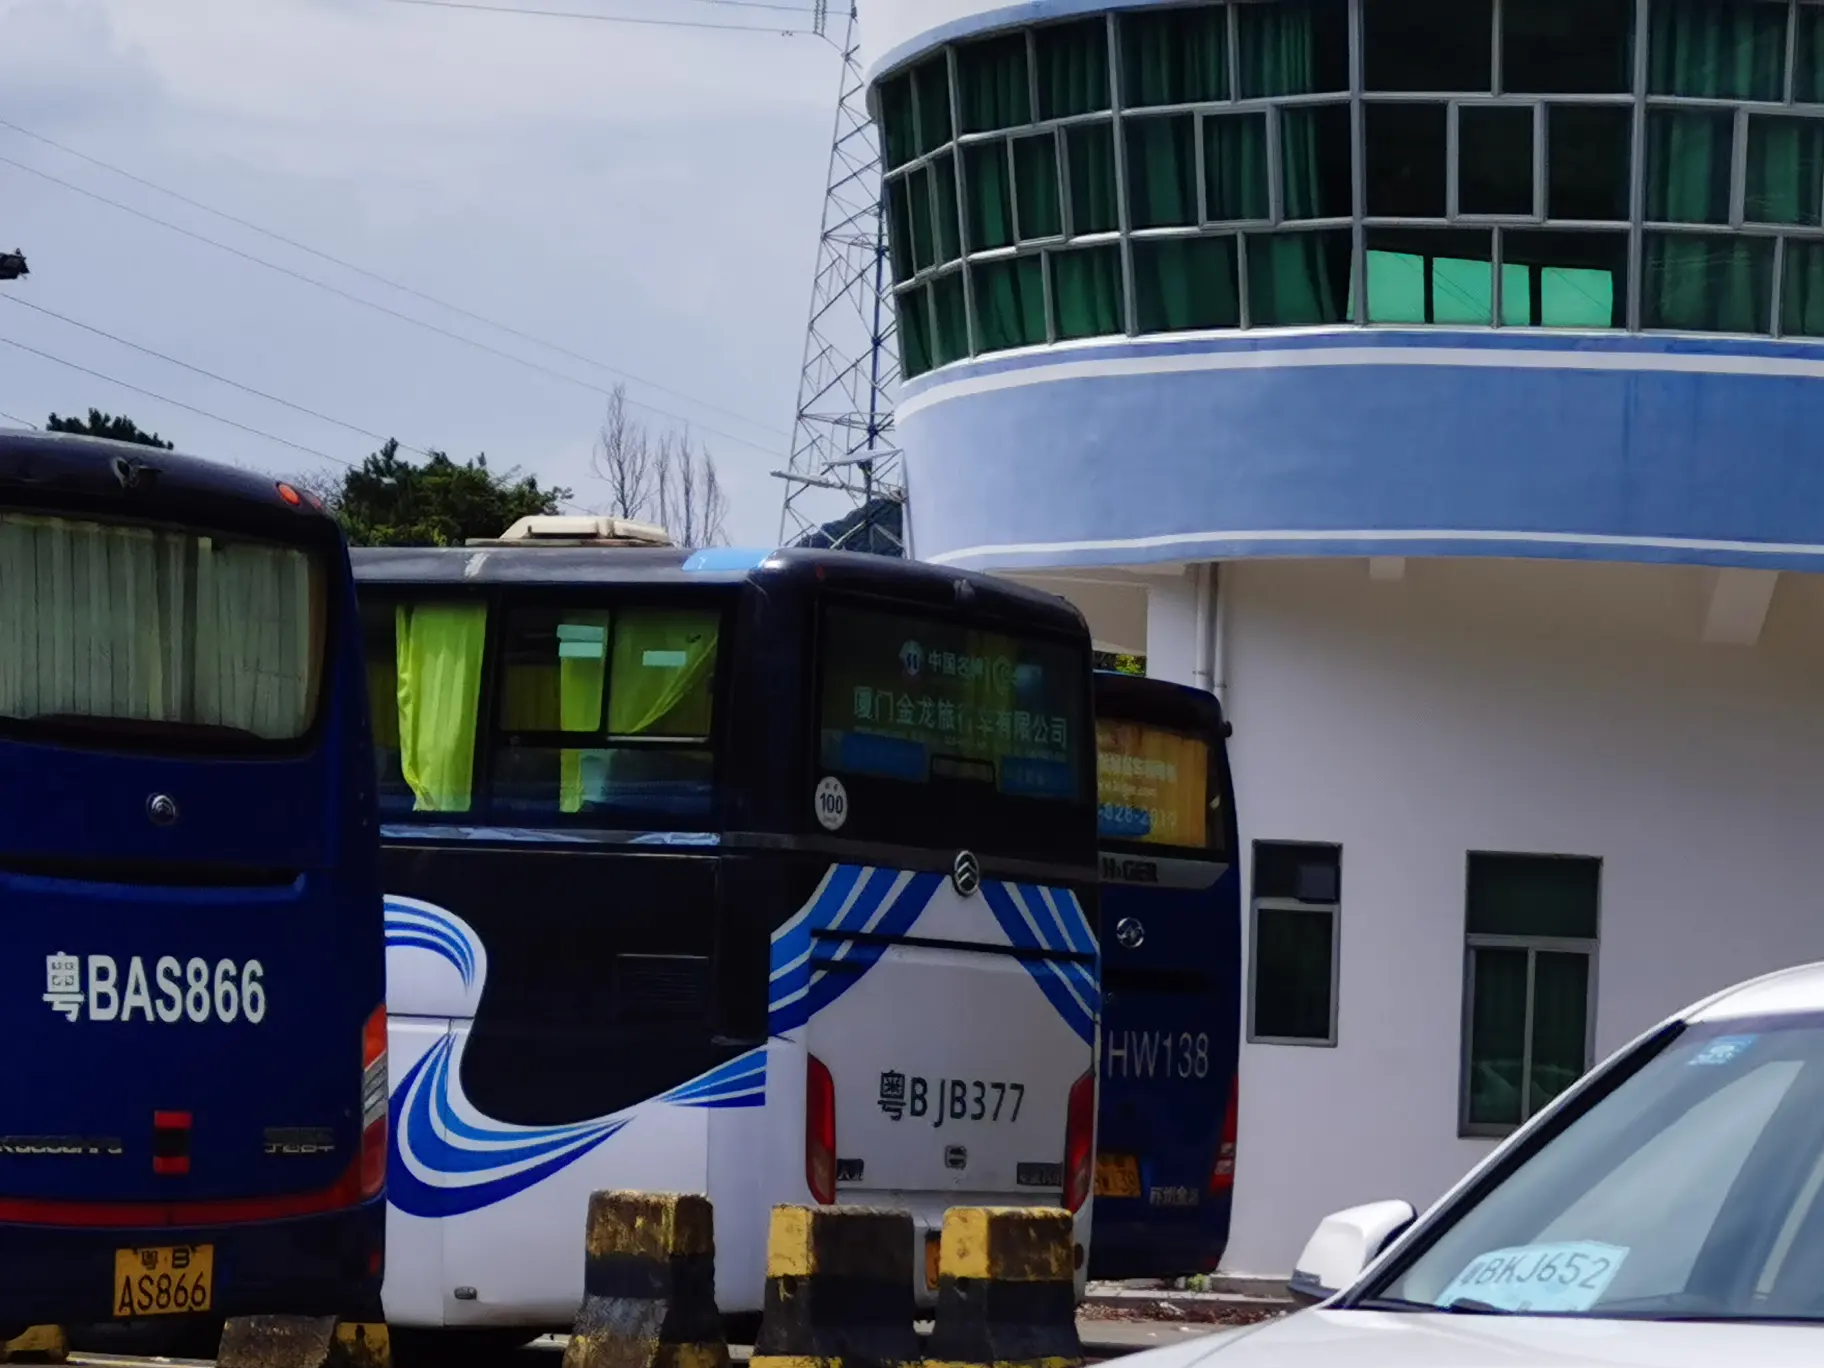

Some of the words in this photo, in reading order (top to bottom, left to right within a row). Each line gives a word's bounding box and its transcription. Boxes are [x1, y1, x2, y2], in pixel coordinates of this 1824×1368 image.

[820, 792, 844, 814] 100
[43, 952, 266, 1024] 粤BAS866
[1108, 1030, 1209, 1079] HW138
[118, 1271, 207, 1313] AS866
